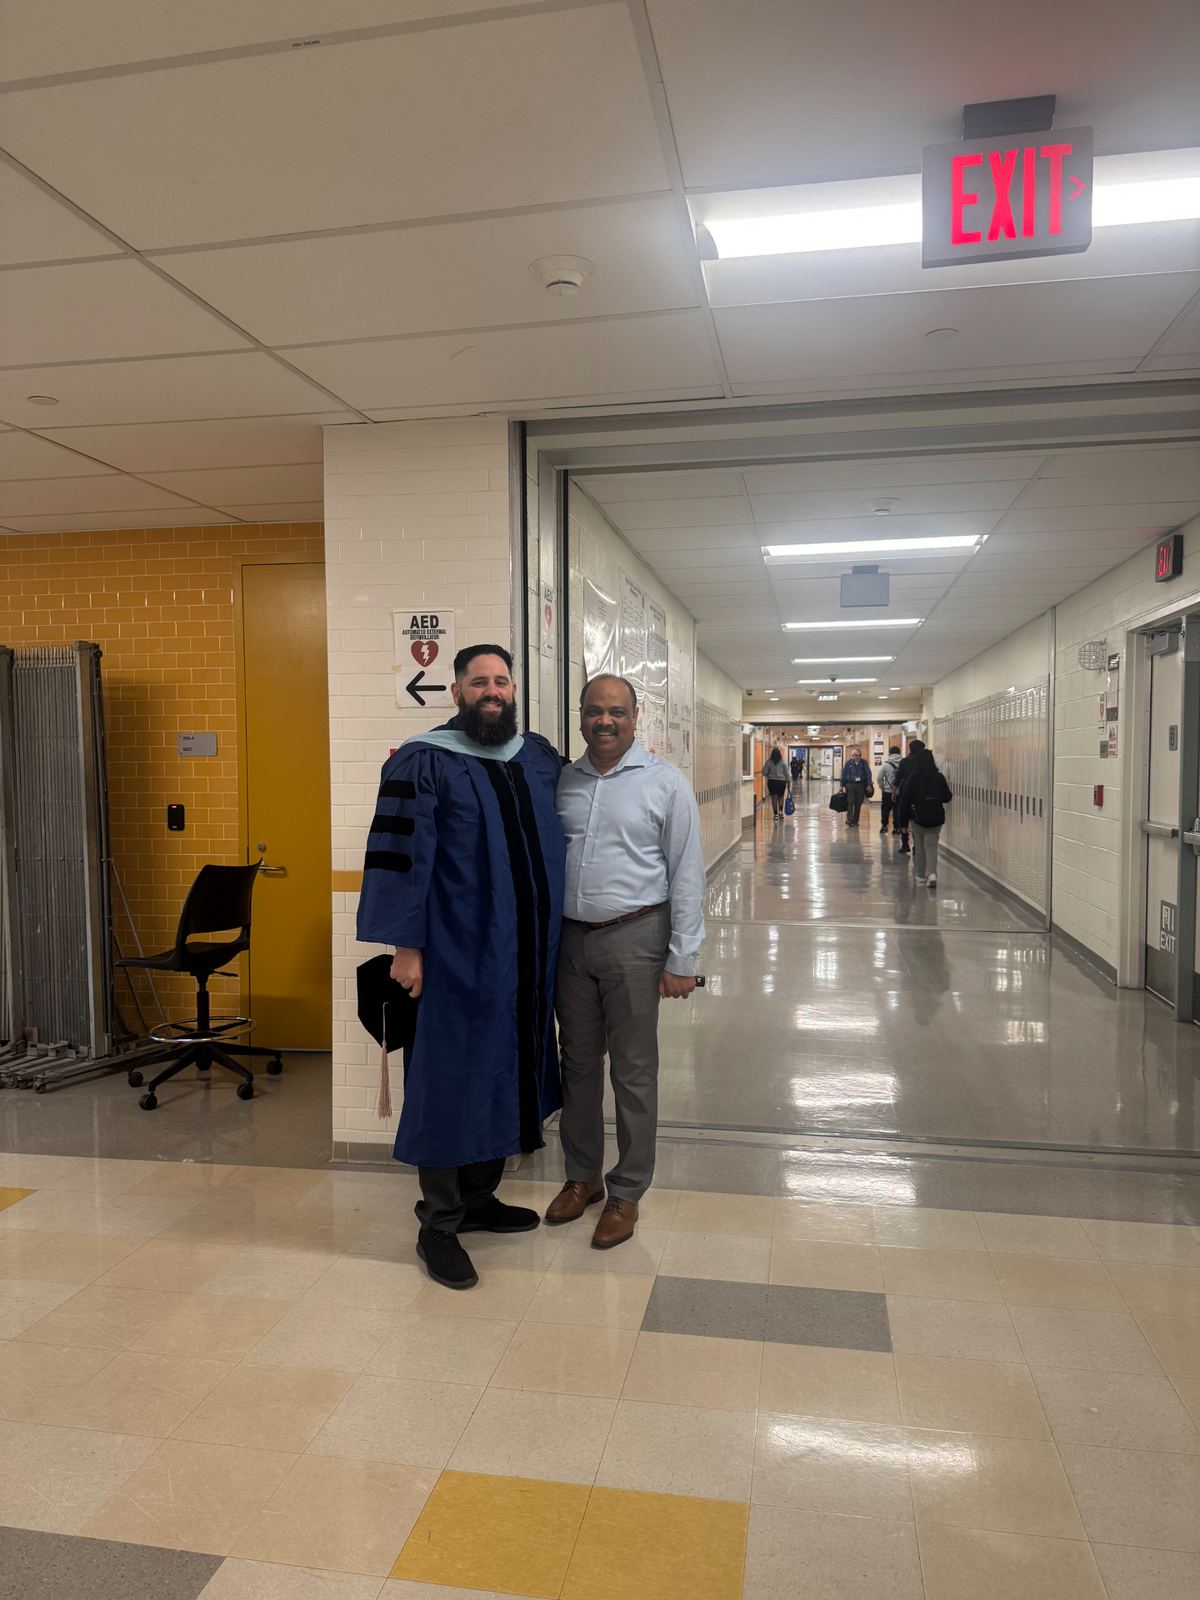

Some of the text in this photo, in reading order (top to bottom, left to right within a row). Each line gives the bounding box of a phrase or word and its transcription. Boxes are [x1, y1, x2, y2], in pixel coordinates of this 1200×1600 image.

[951, 143, 1073, 245] EXIT
[410, 615, 440, 629] AED
[1160, 930, 1176, 954] EXIT
